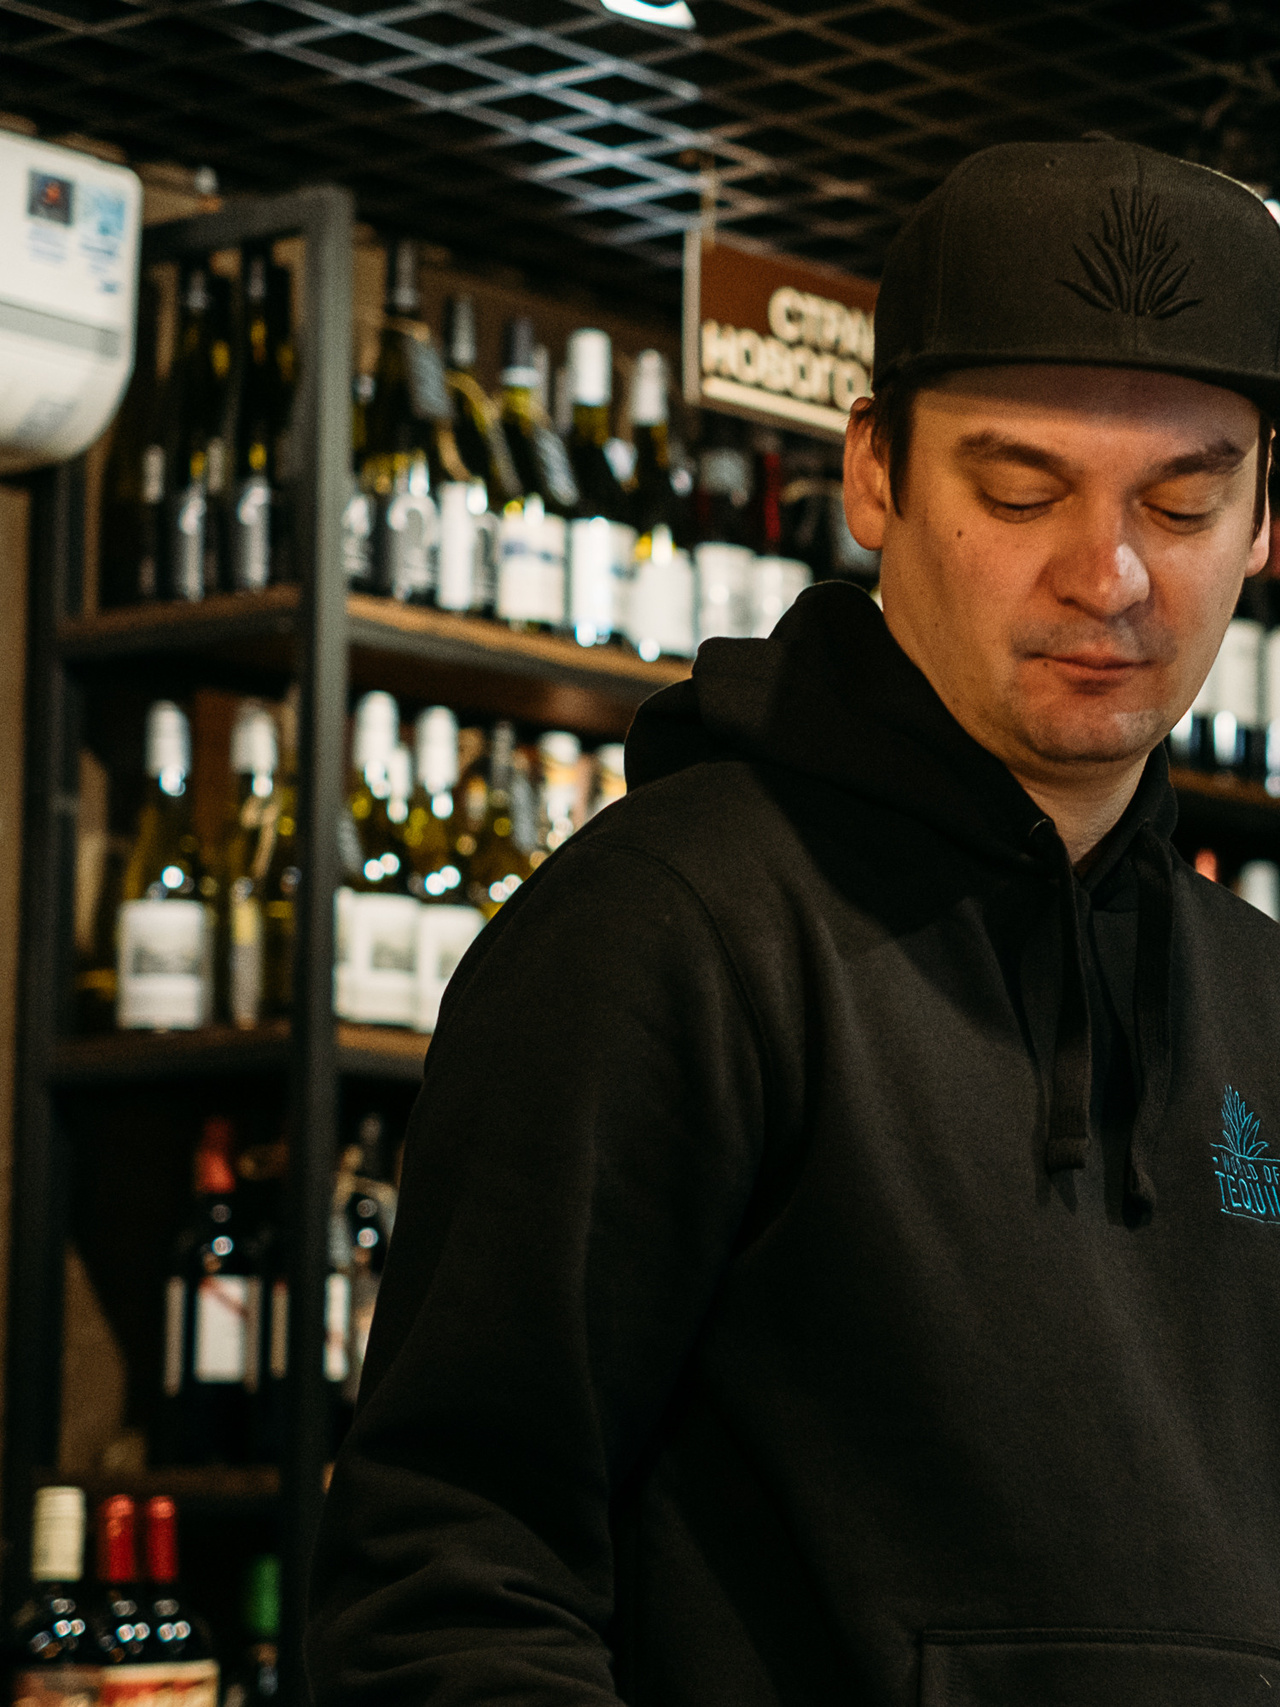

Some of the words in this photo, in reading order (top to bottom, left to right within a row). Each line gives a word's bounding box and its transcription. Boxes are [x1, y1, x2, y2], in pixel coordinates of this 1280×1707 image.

[769, 287, 873, 366] СТРА
[1220, 1151, 1259, 1181] WORLD
[1262, 1164, 1280, 1185] OF
